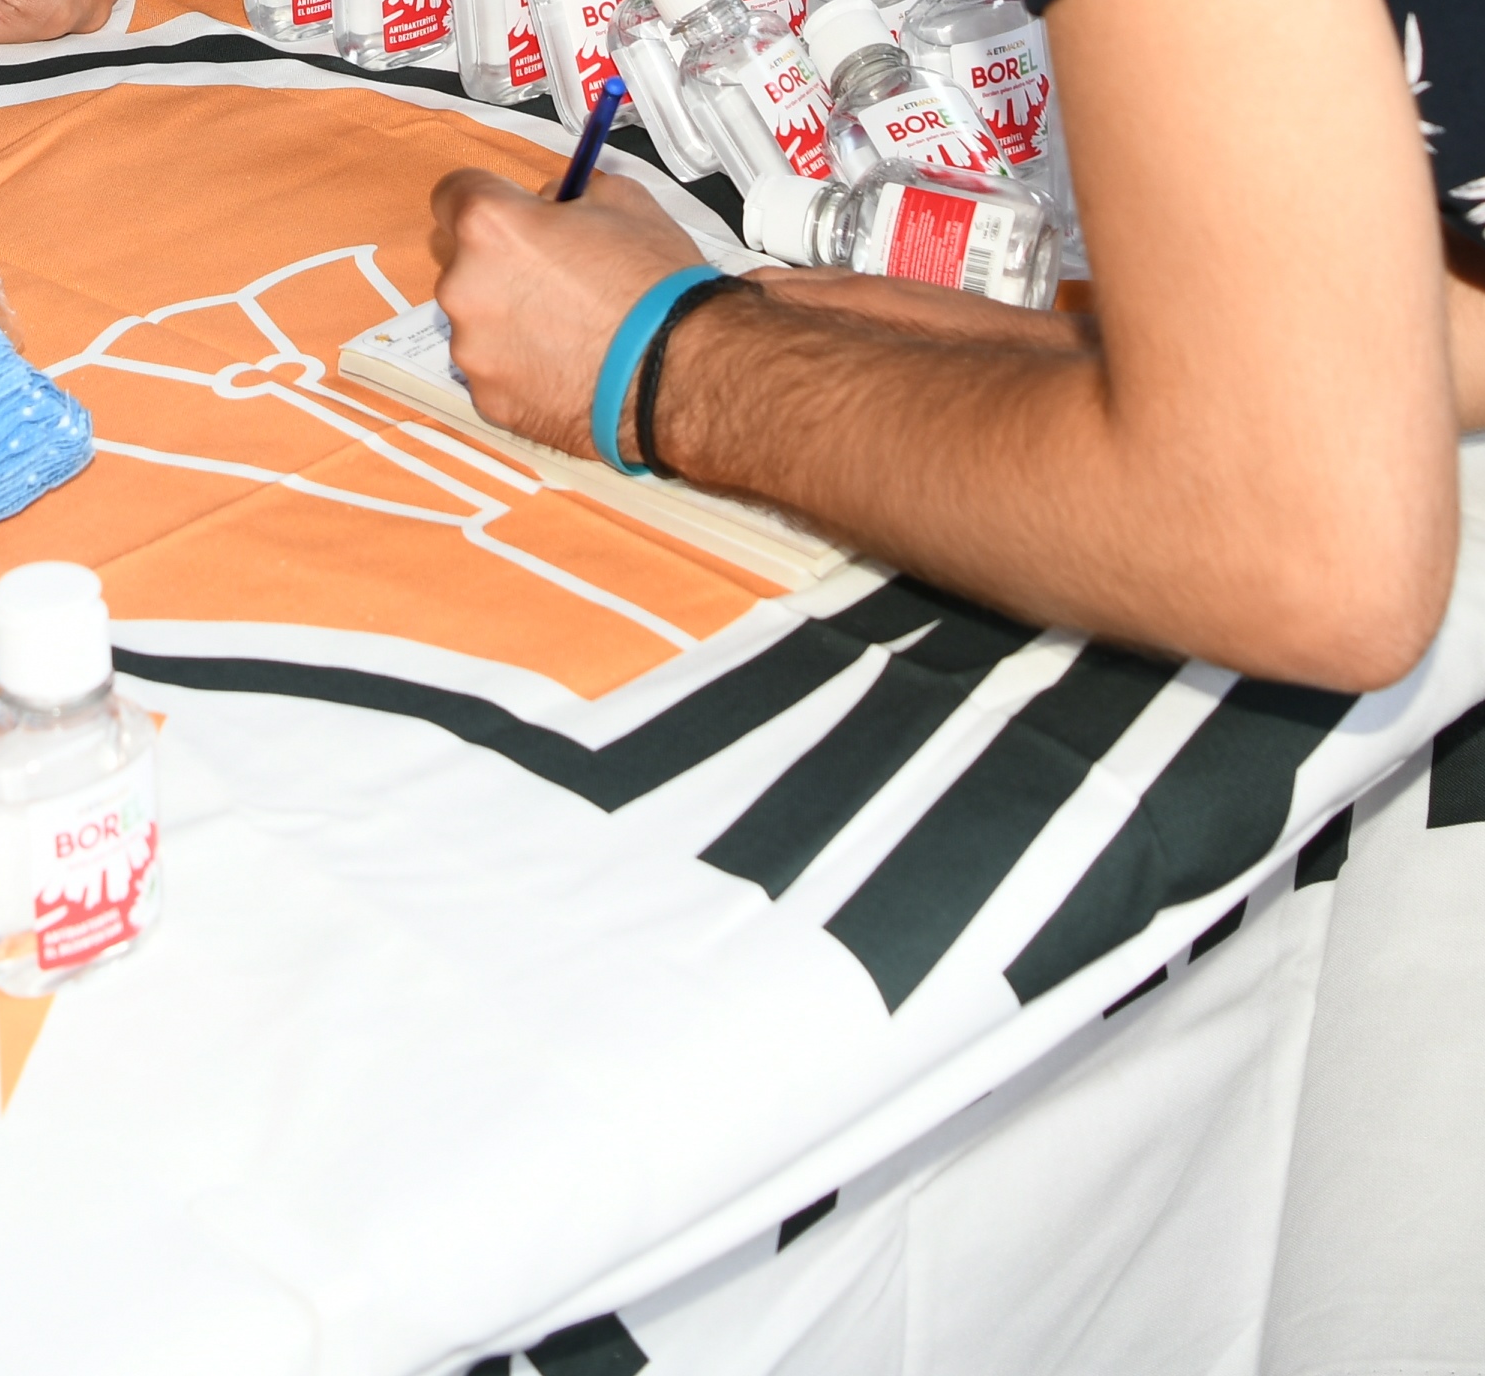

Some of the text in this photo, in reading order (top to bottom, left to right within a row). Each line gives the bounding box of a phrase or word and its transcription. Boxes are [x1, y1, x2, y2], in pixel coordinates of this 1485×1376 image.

[389, 35, 398, 44] EL
[765, 57, 815, 104] BOREL
[971, 49, 1038, 88] BOREL
[55, 801, 145, 860] BOREL
